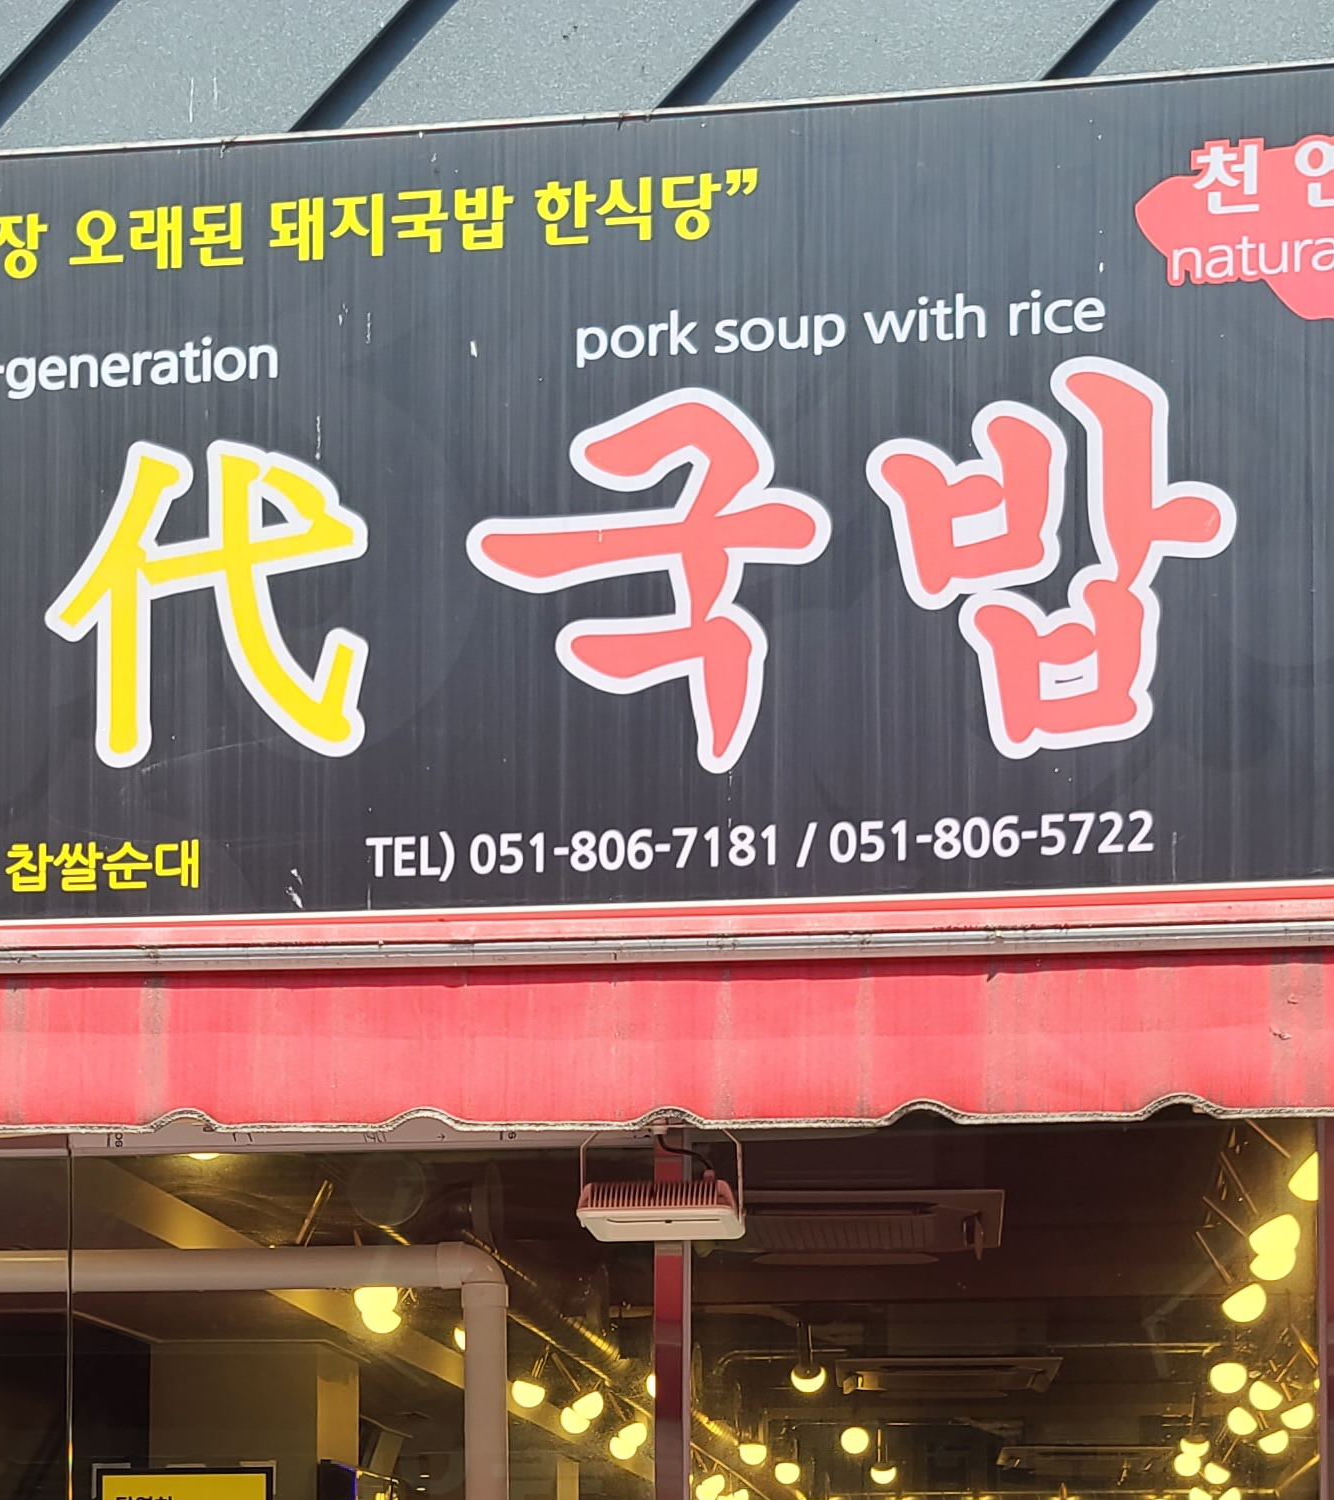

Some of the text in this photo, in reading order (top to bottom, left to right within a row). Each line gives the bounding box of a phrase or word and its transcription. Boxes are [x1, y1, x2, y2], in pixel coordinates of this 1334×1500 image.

[68, 199, 246, 270] 오래된
[269, 187, 516, 265] 돼지국밥
[575, 290, 1107, 367] pork soup with rice
[466, 353, 1238, 776] 국밥
[4, 837, 201, 894] 찹쌀순대
[364, 830, 456, 883] TEL)
[469, 821, 781, 876] 051-806-7181
[827, 808, 1155, 865] 051-806-5722
